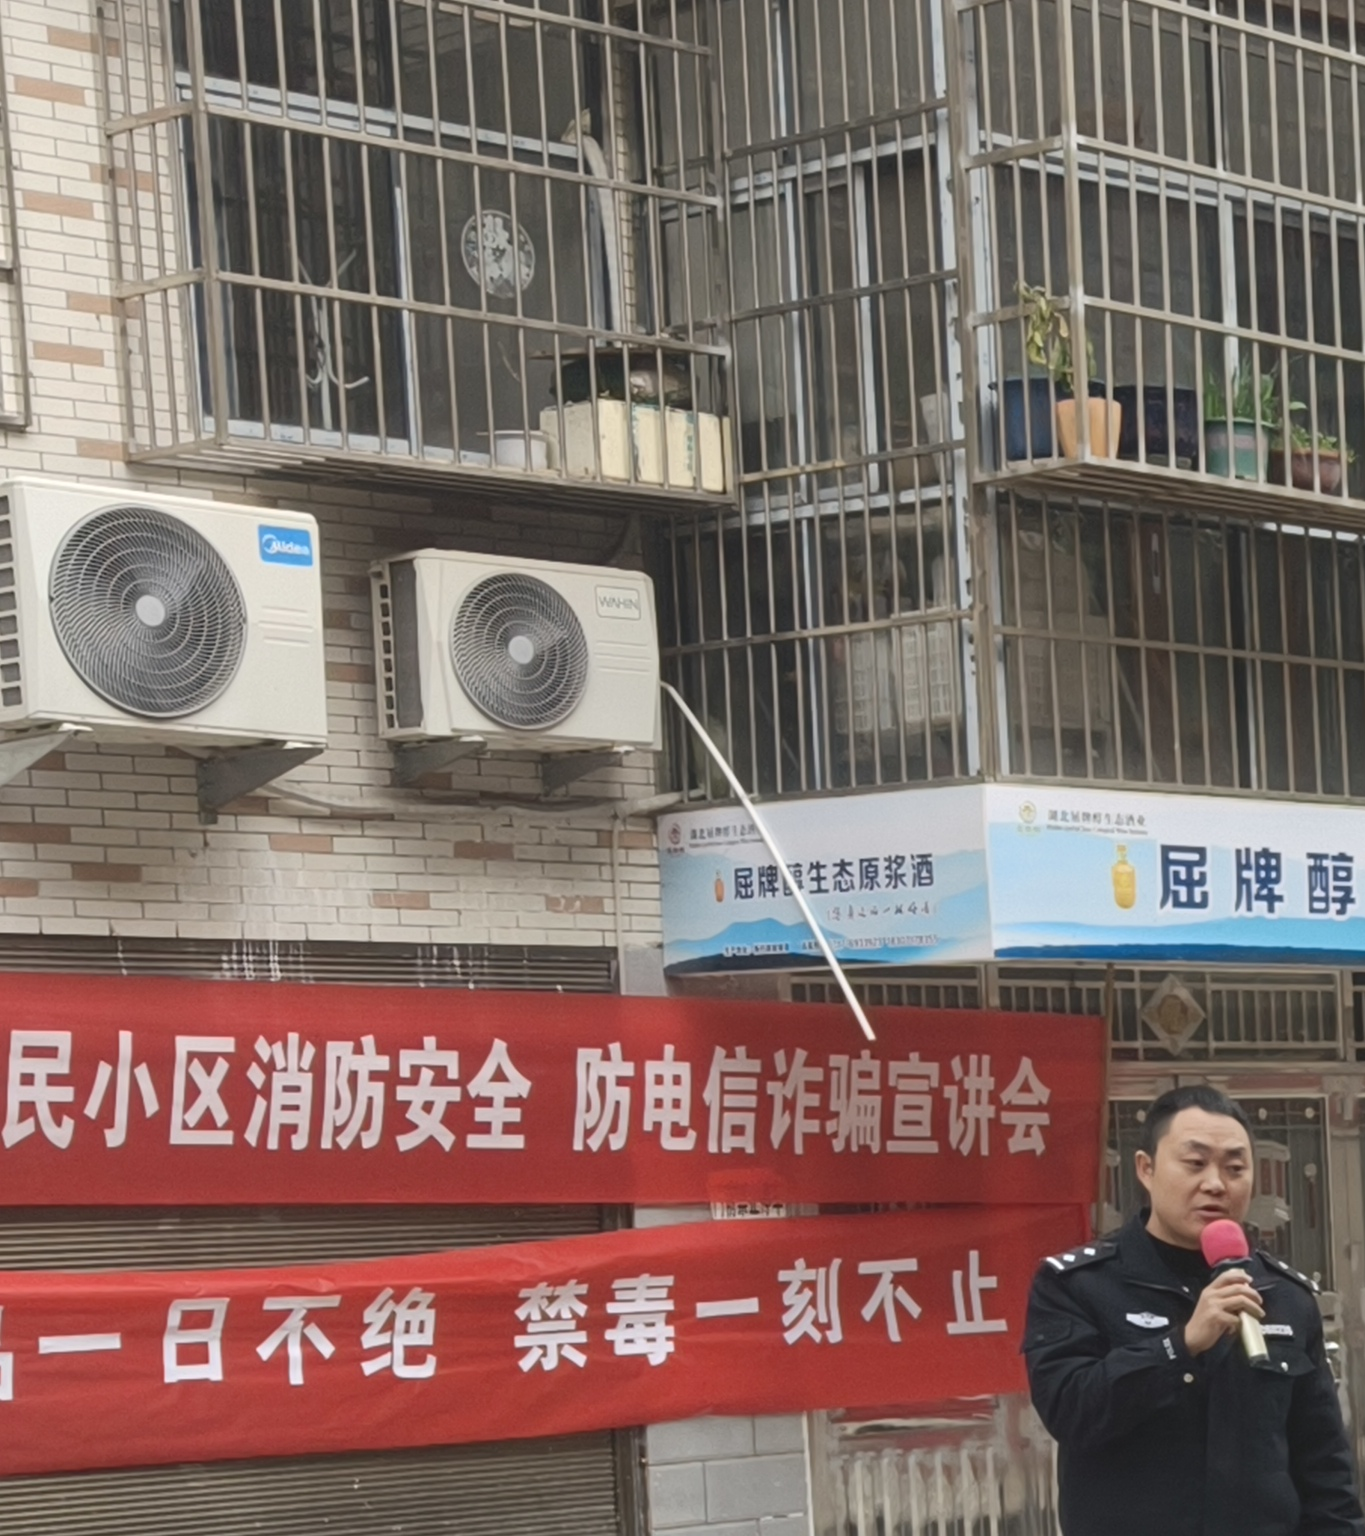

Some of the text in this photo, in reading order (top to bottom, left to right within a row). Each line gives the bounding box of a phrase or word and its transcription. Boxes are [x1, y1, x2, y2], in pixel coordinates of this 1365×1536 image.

[1, 1030, 1052, 1157] 民小区消防安全 防电信诈骗宣讲会
[0, 1249, 1008, 1401] 一日不绝 禁毒一刻不止
